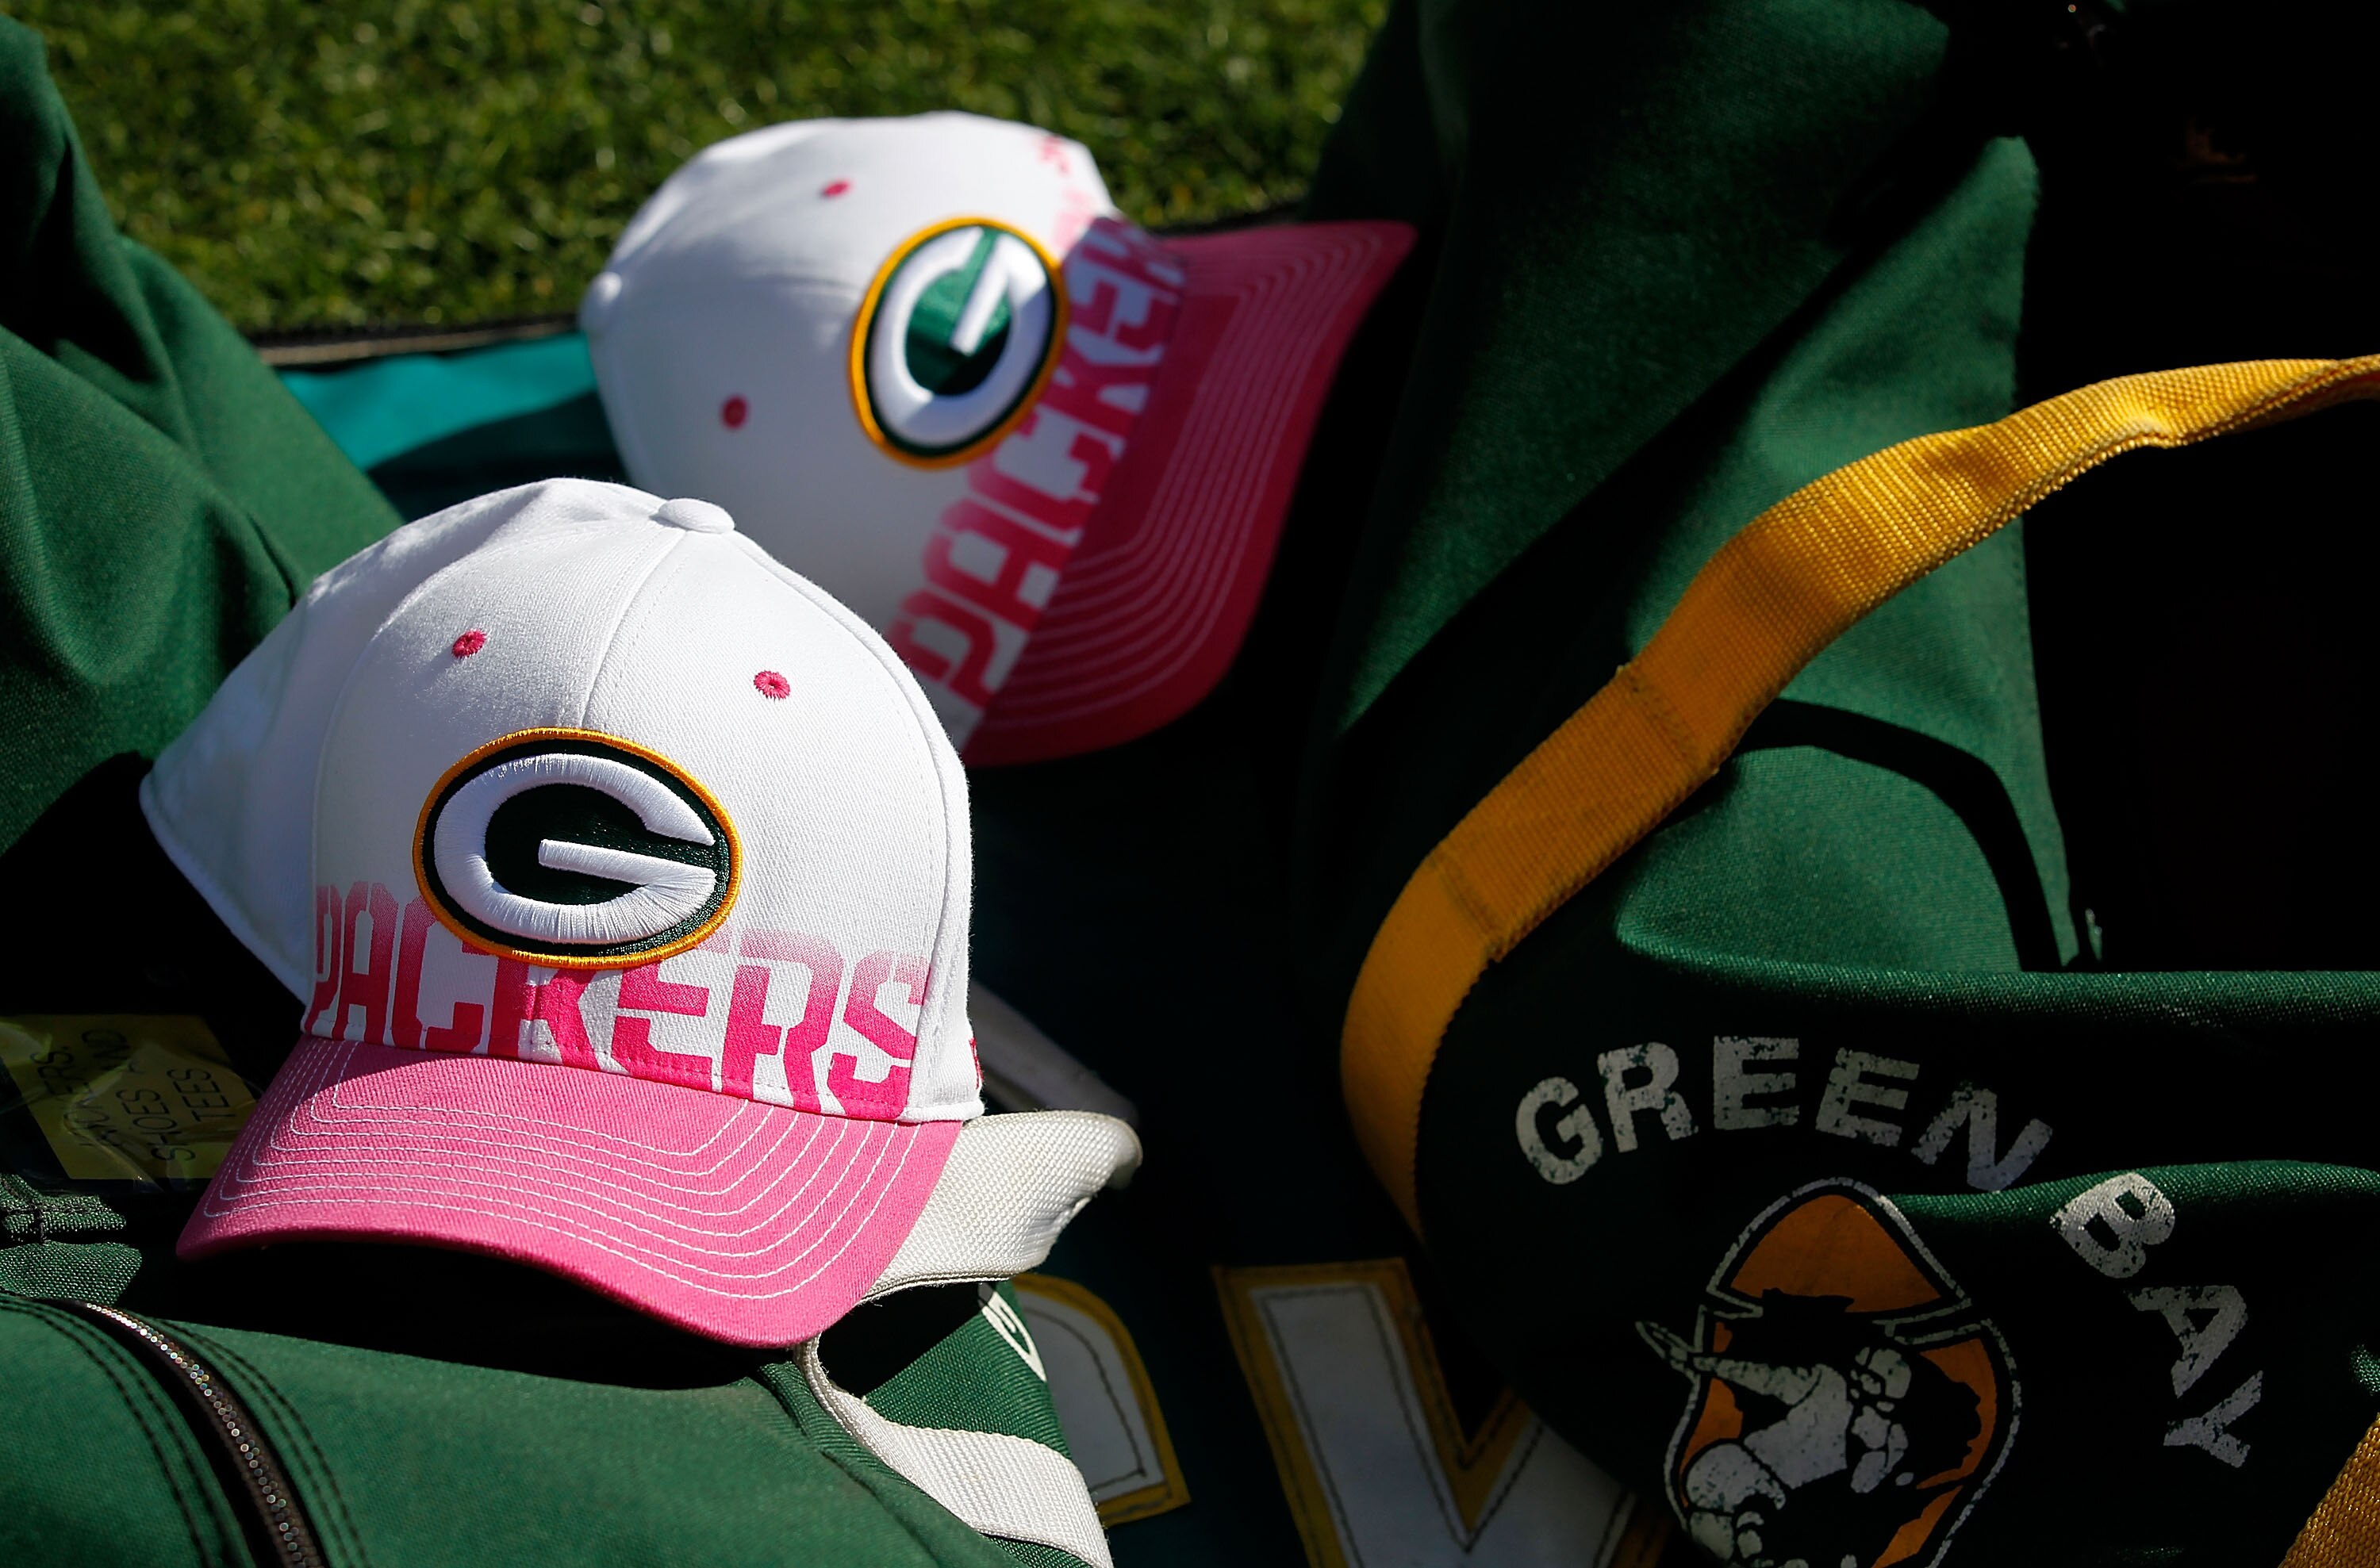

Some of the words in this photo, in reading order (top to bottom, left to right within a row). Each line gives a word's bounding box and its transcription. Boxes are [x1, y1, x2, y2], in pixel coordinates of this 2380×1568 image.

[873, 225, 1048, 447] G
[434, 753, 717, 945] G
[167, 1068, 237, 1122] TEES
[307, 880, 930, 1120] PACKERS
[117, 1089, 197, 1163] SHOES
[1514, 1035, 2053, 1193] GREEN
[2051, 1171, 2263, 1469] BAY
